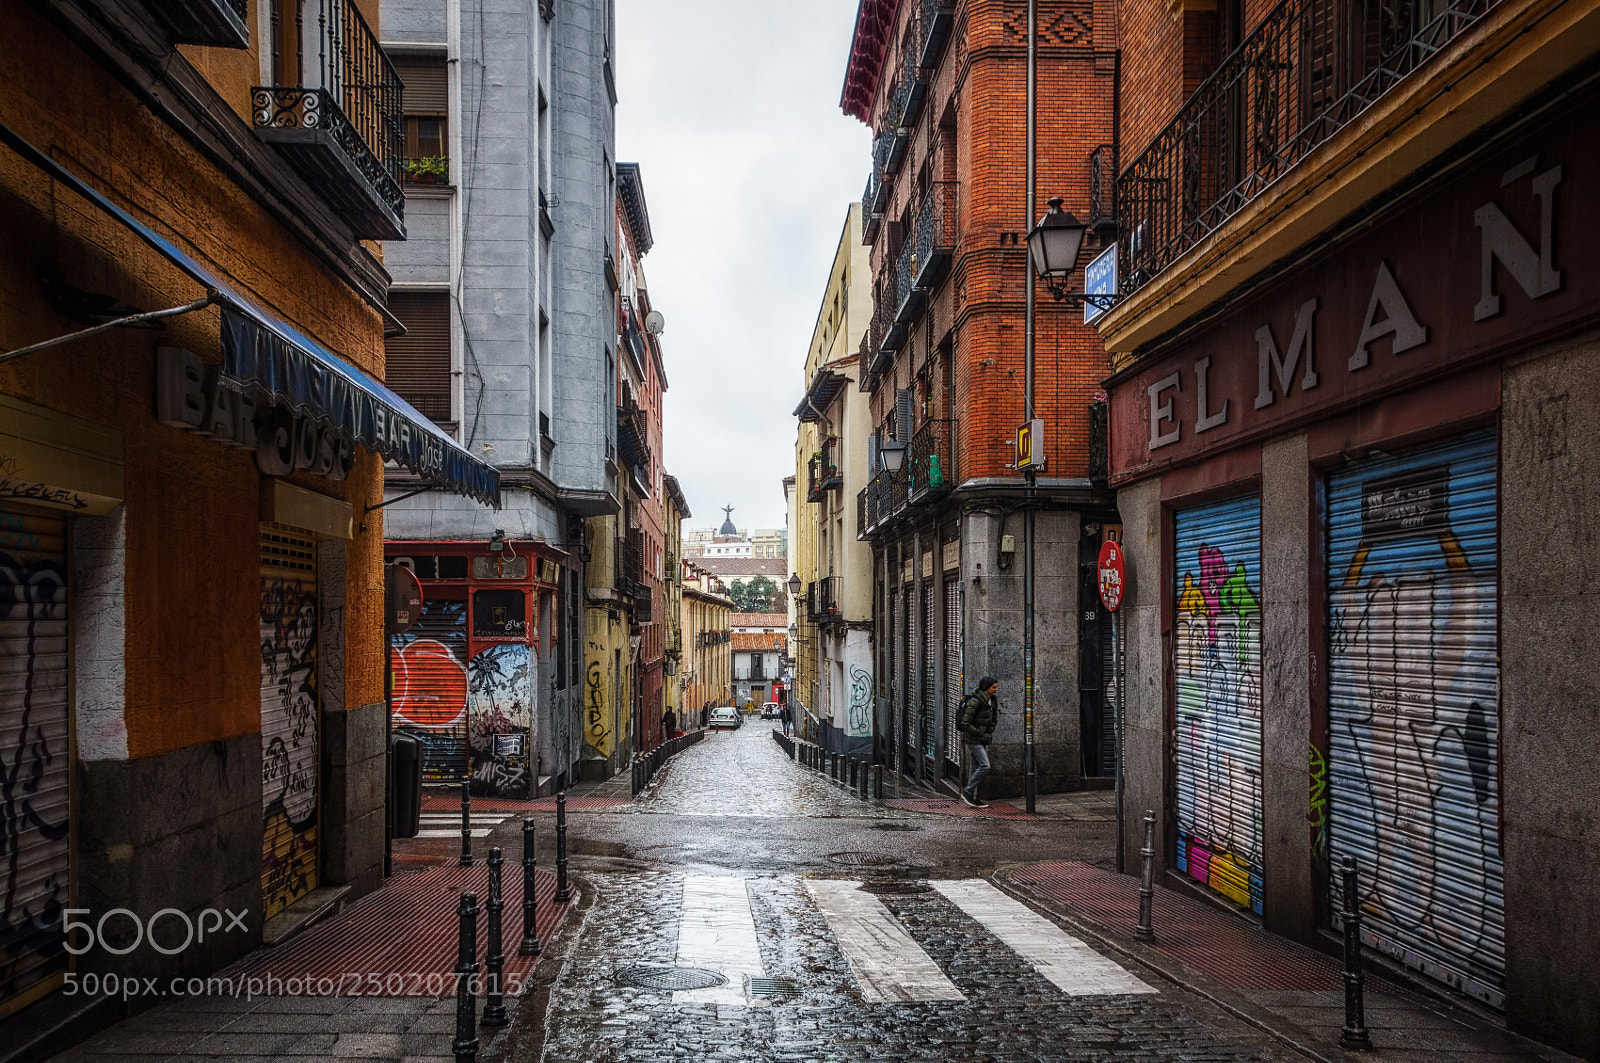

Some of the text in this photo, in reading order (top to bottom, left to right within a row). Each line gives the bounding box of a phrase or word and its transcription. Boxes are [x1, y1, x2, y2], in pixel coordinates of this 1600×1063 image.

[1148, 153, 1564, 451] EL MAÑ
[157, 346, 258, 450] BAR
[375, 405, 411, 454] BAR
